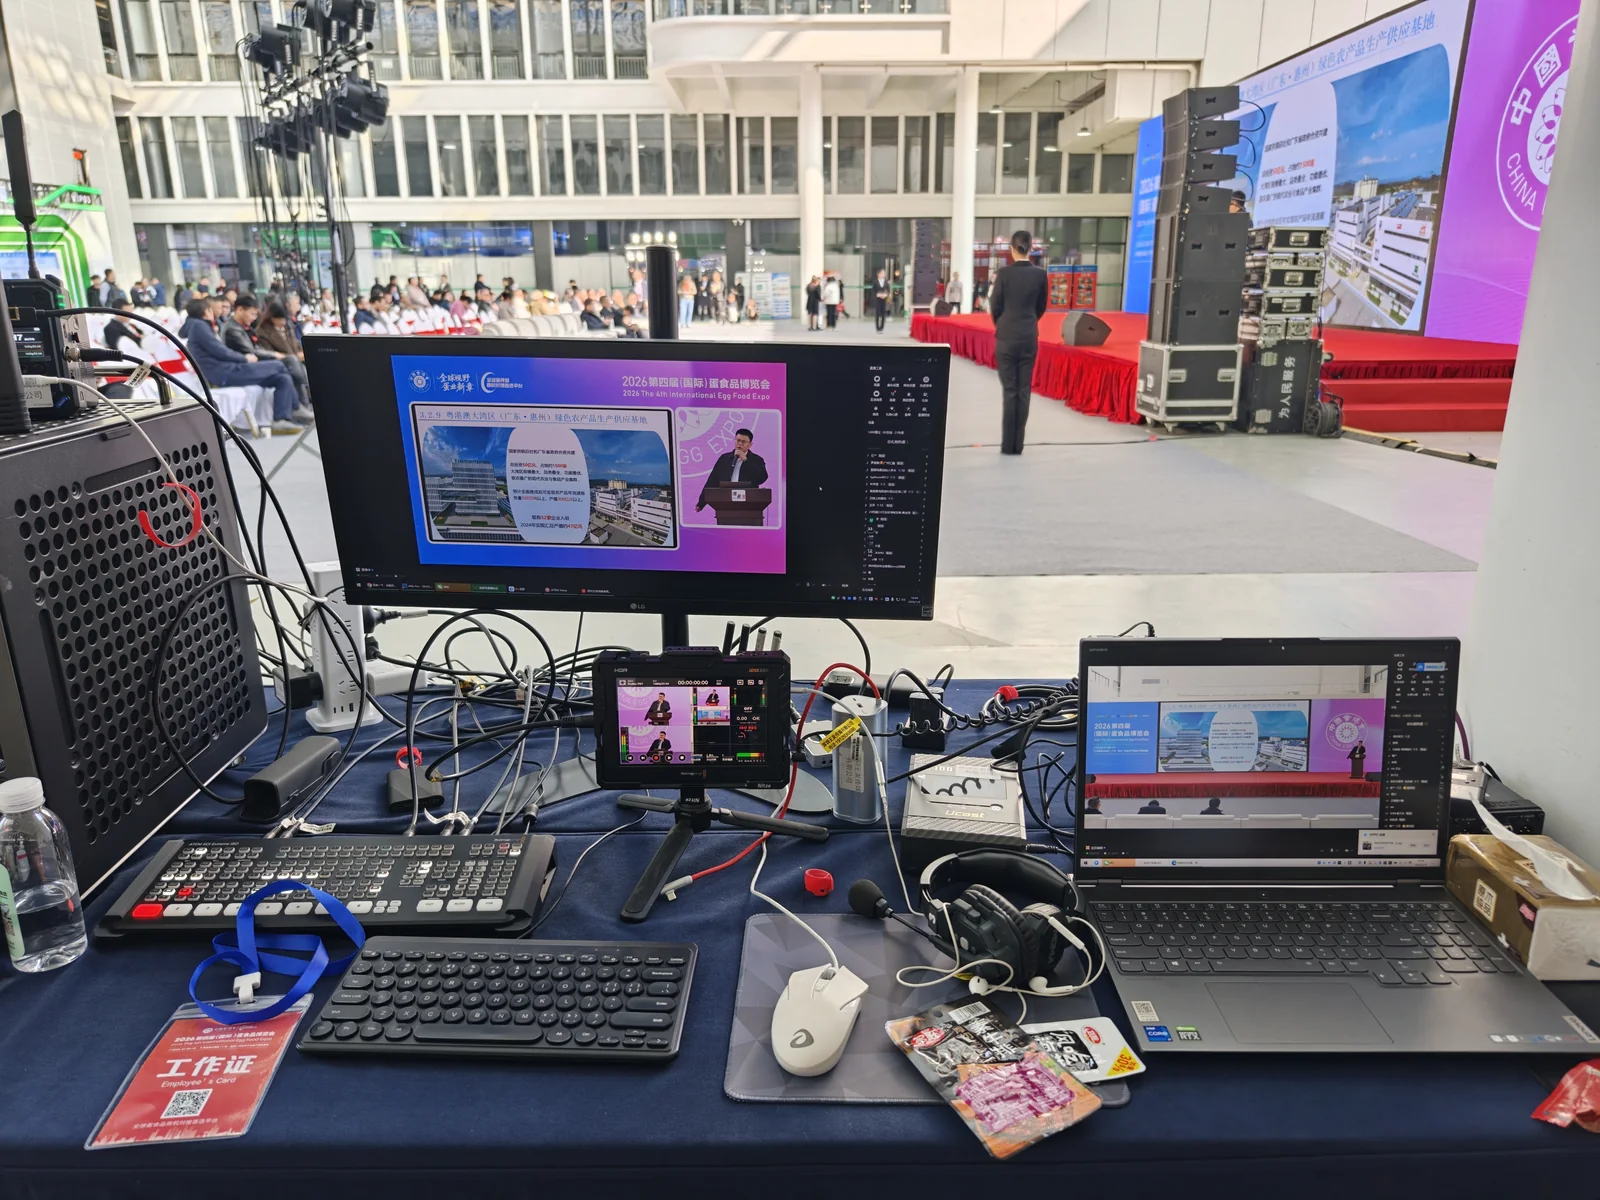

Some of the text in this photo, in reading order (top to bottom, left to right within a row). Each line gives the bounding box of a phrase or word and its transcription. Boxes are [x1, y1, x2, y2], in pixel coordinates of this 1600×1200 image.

[1507, 152, 1537, 212] CHINA
[438, 373, 470, 382] 全球视野
[1278, 356, 1296, 418] 为人民服务
[670, 391, 716, 399] International
[707, 410, 744, 454] EXPO
[156, 1055, 258, 1078] 工作证
[1112, 1054, 1133, 1072] 30%
